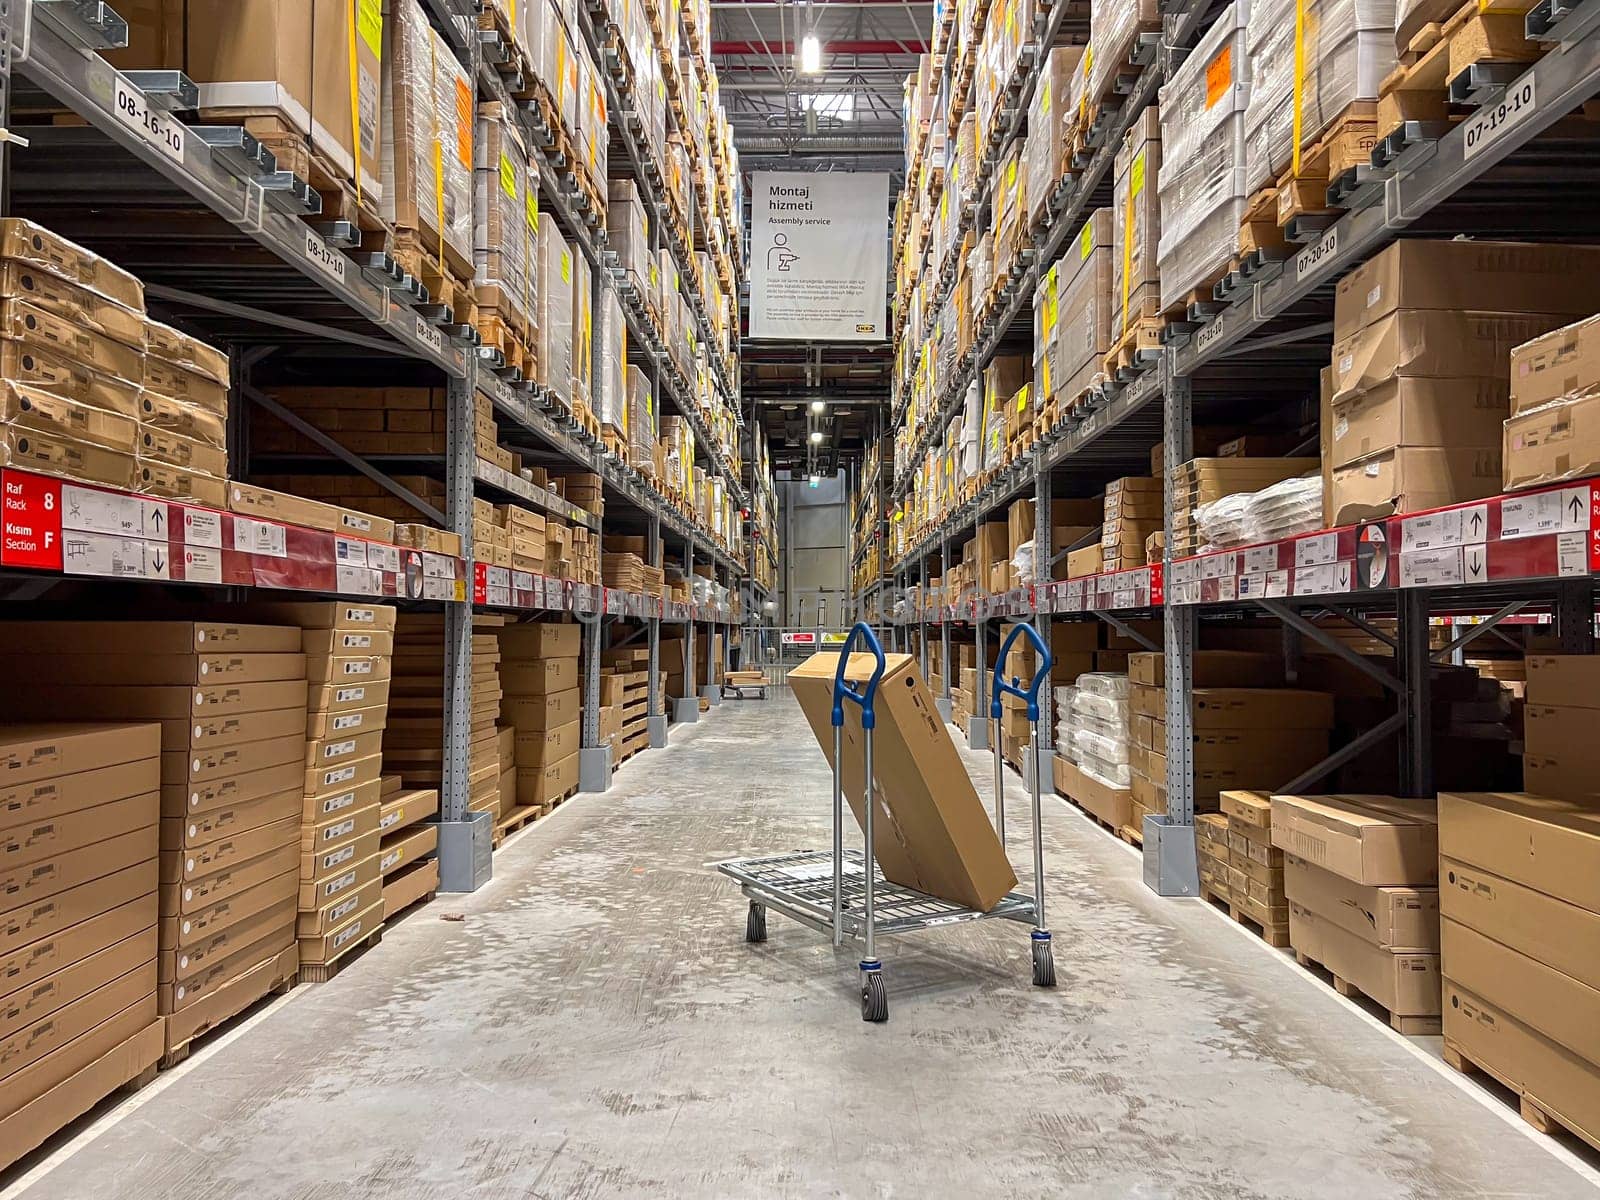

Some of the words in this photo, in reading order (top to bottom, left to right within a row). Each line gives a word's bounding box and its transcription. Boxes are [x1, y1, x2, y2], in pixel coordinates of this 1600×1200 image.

[118, 90, 181, 152] 08-16-10
[1466, 84, 1532, 148] 07-19-10
[769, 186, 810, 199] Montaj
[769, 200, 813, 211] hizmeti
[768, 217, 804, 226] Assembly
[805, 217, 831, 226] service
[306, 237, 344, 276] 08-17-10
[1298, 234, 1336, 274] 07-20-10
[6, 482, 23, 495] Raf
[6, 498, 27, 511] Rack
[43, 492, 54, 511] 8
[6, 522, 32, 537] Kısım
[6, 538, 37, 552] Section
[44, 531, 54, 549] F
